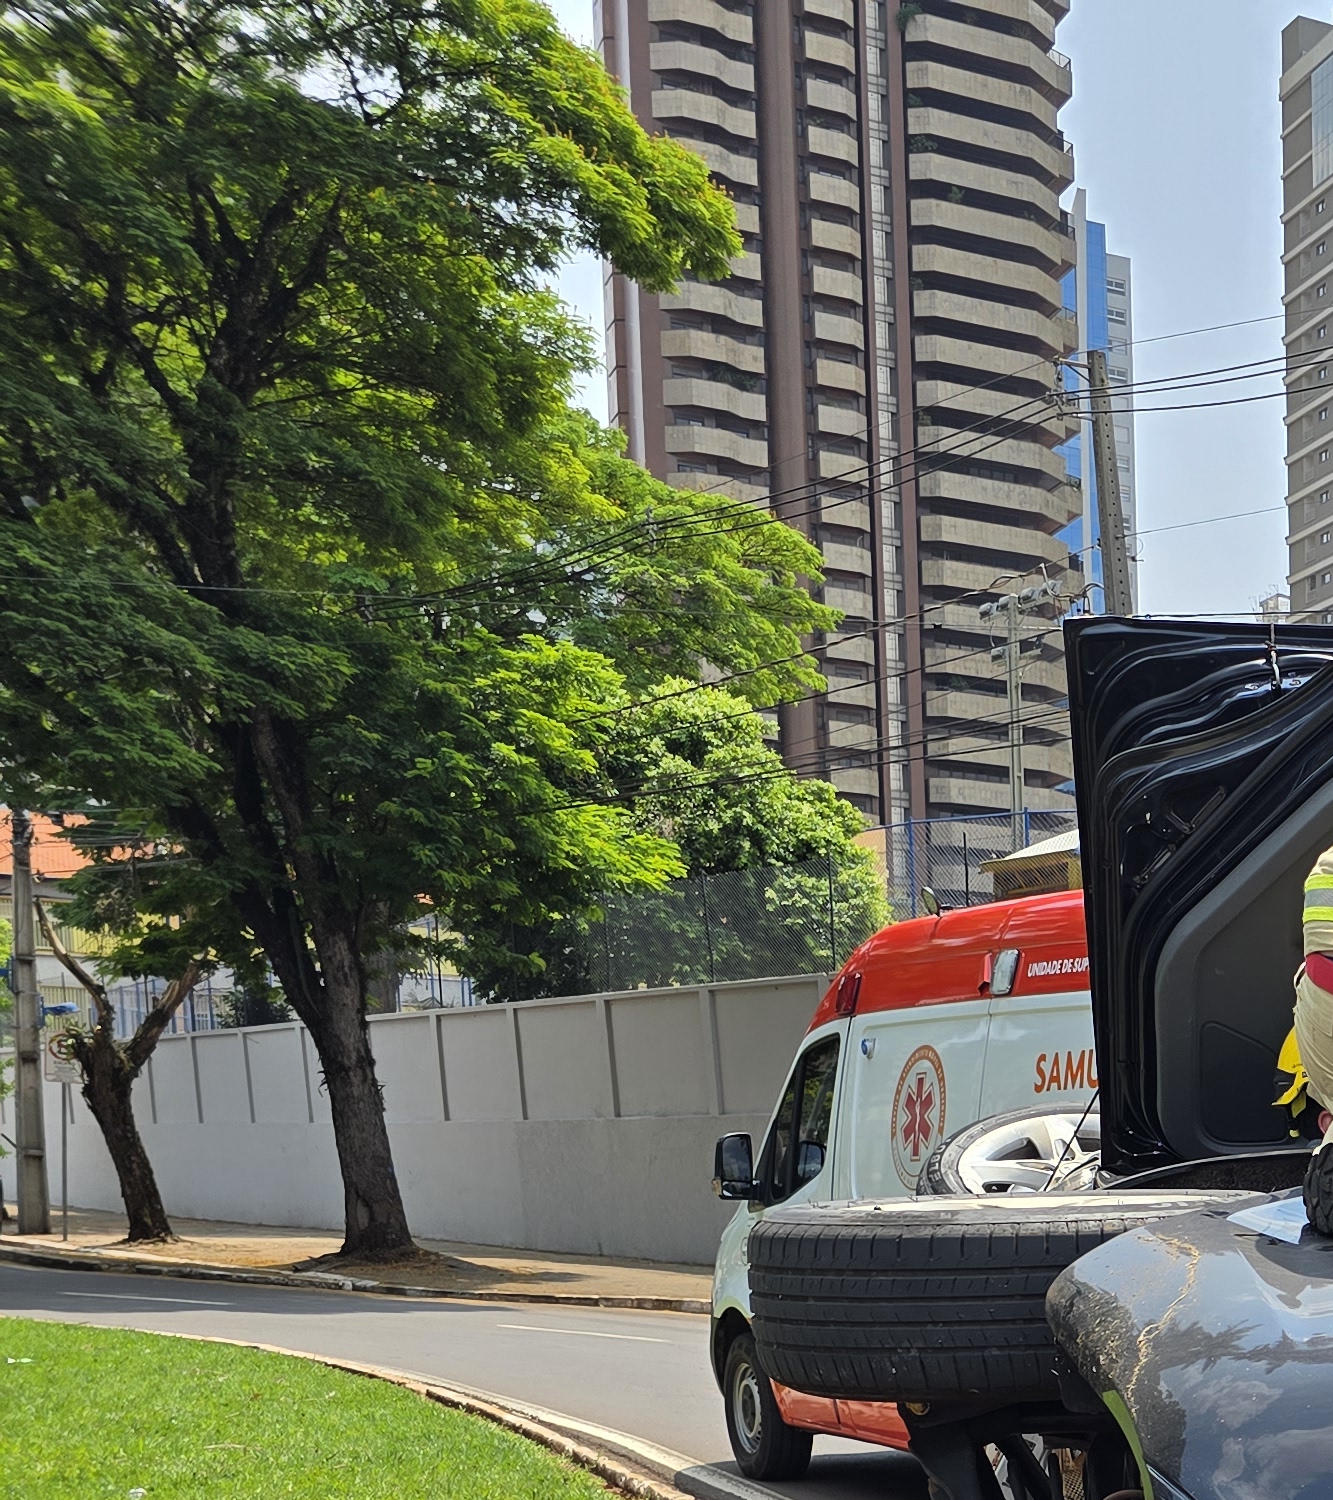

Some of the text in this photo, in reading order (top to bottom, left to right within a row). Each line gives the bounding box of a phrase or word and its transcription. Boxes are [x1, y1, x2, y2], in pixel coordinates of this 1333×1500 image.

[1028, 956, 1090, 978] UNIDADE DE SUP
[1034, 1048, 1099, 1094] SAMU
